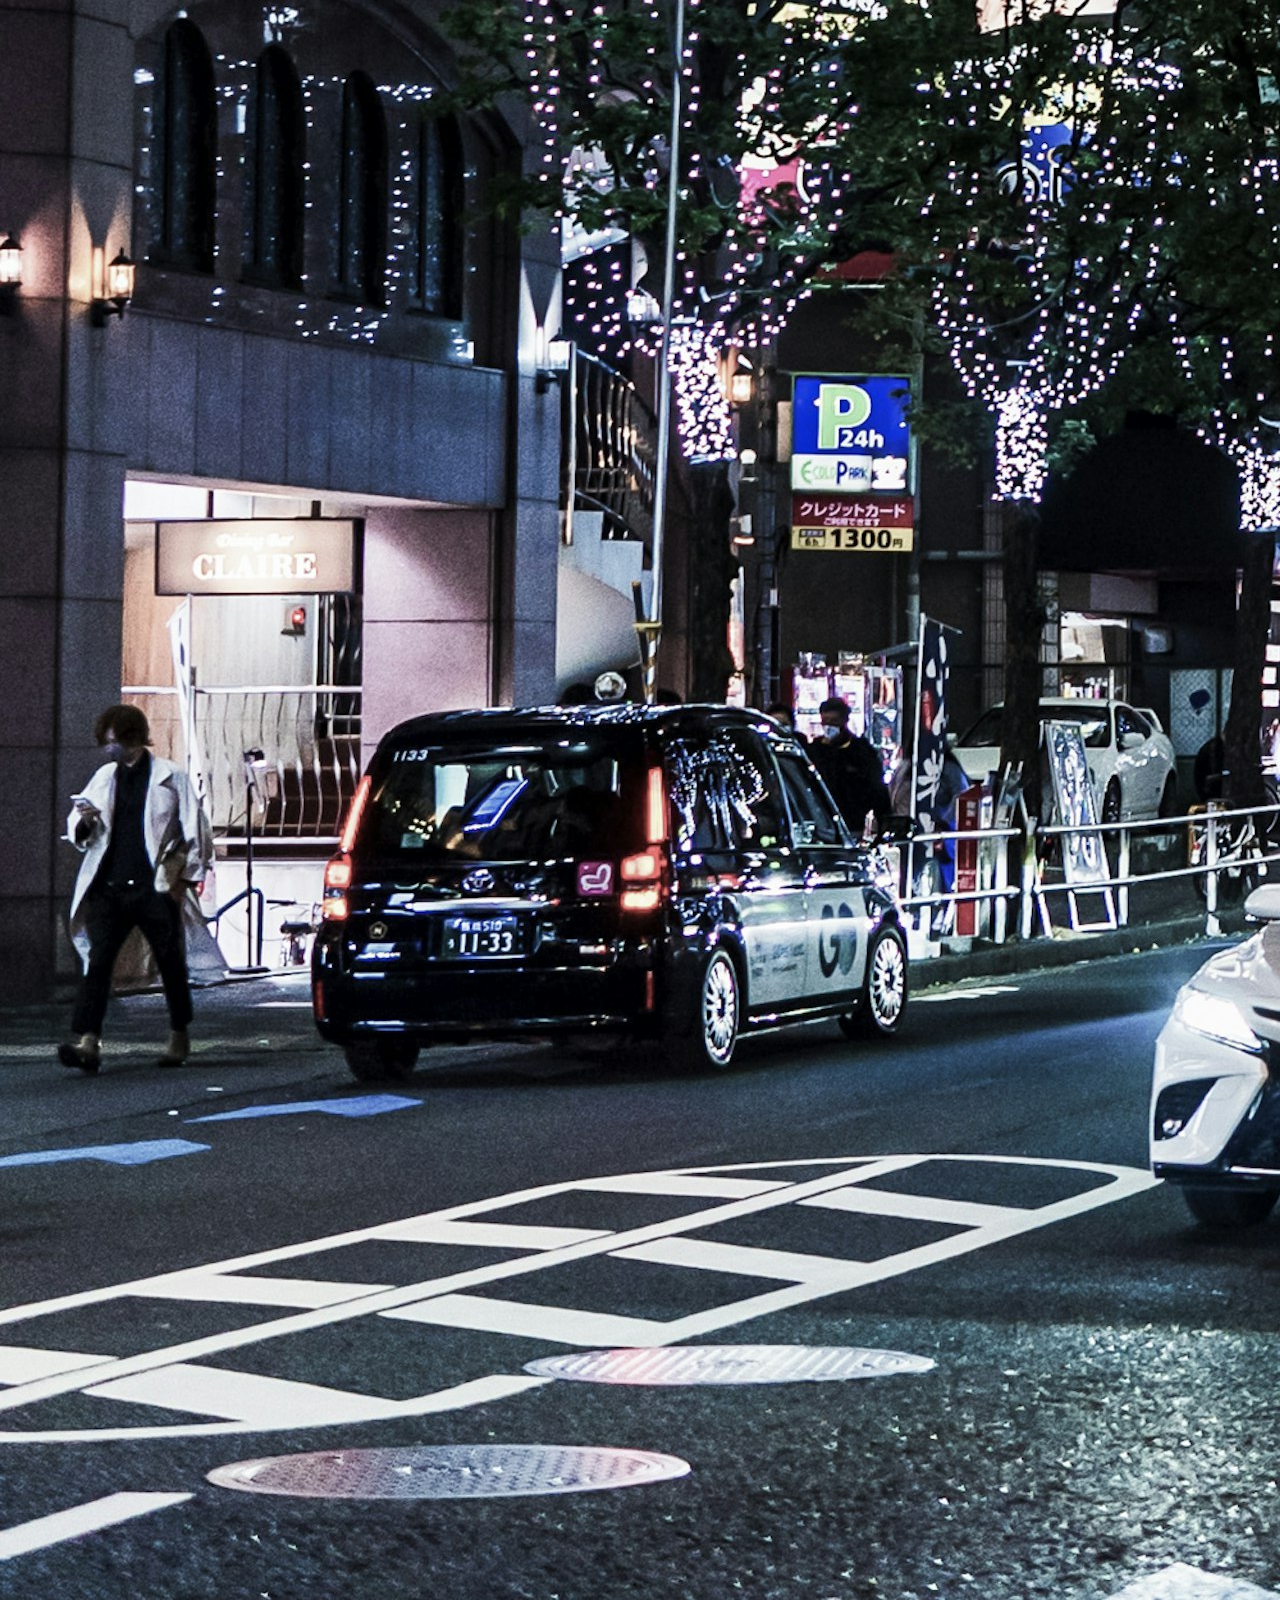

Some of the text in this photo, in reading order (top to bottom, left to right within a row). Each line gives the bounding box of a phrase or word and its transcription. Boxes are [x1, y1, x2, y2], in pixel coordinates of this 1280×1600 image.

[818, 383, 871, 449] P
[840, 429, 884, 448] 24h
[800, 502, 906, 518] クレジットカード
[193, 553, 317, 580] CLAIRE
[393, 749, 429, 762] 1133
[460, 931, 513, 953] 11-33
